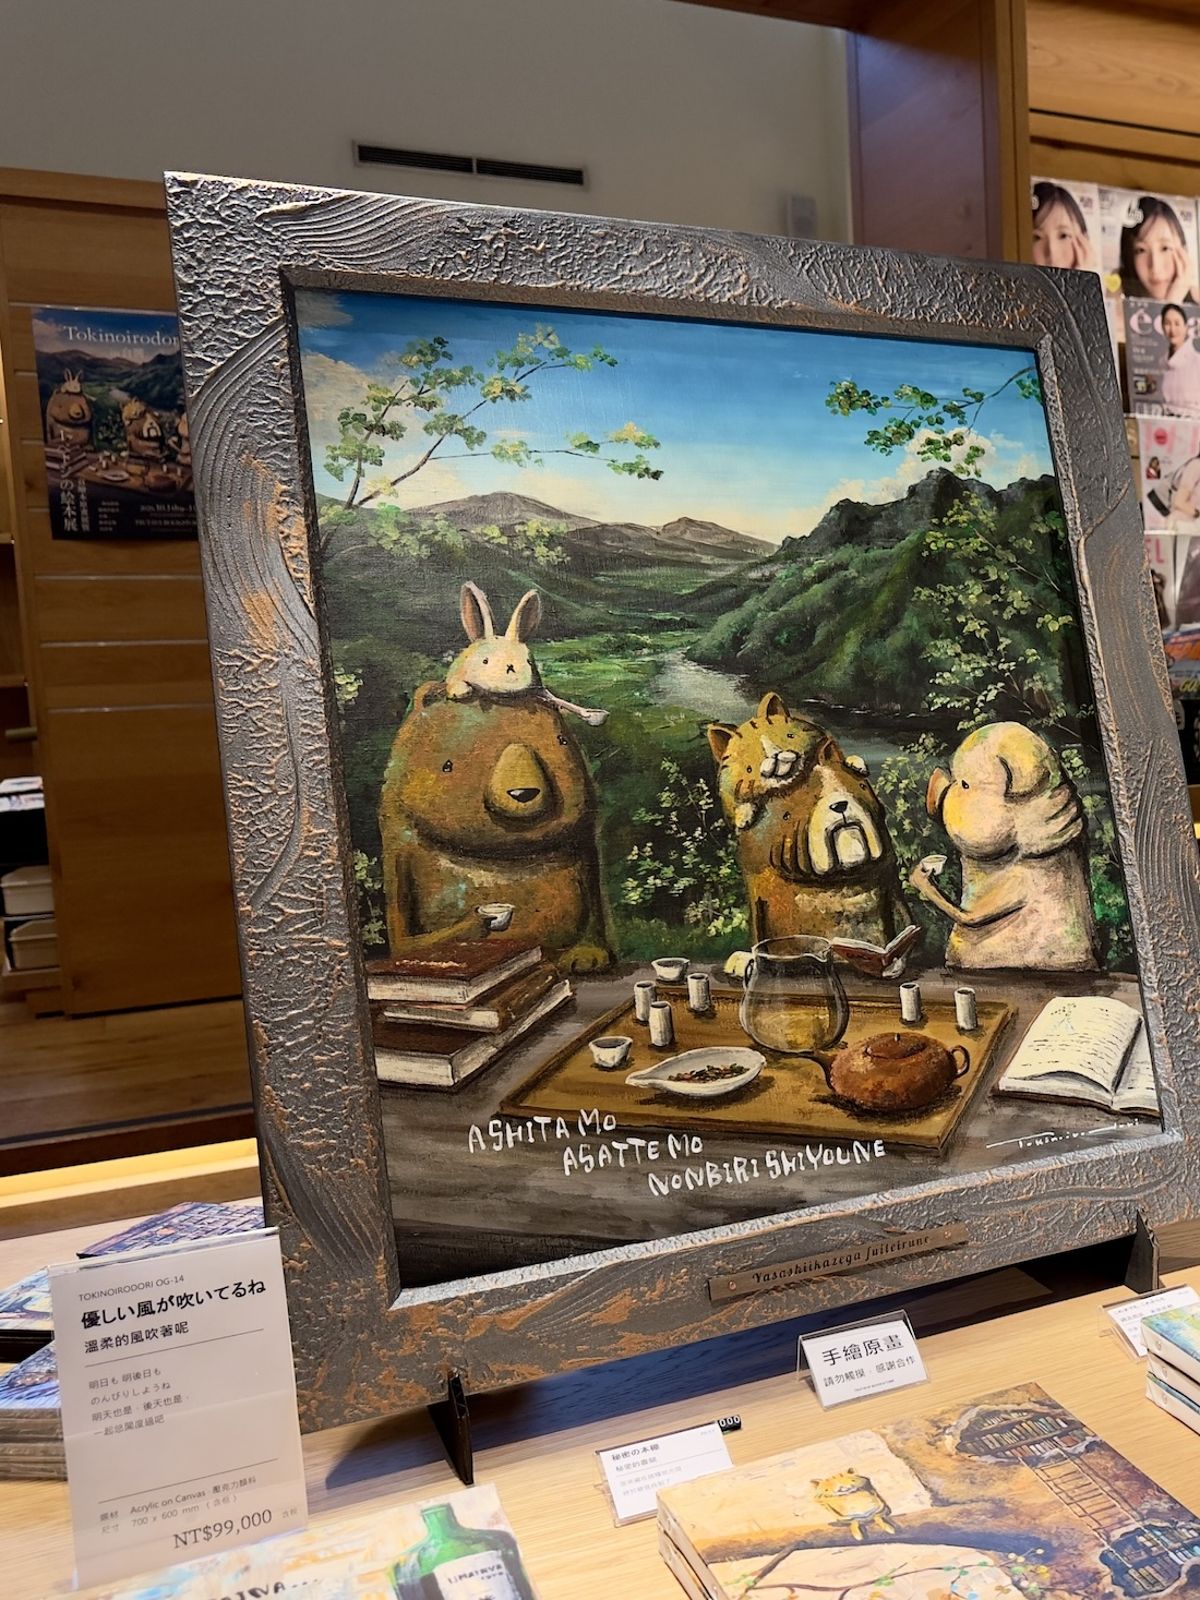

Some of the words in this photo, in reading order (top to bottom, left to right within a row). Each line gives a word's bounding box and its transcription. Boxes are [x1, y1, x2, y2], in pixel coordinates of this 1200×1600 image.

[468, 1115, 570, 1153] ASHITA
[577, 1108, 617, 1137] MO
[563, 1137, 660, 1177] ASATTE
[668, 1133, 703, 1160] MO
[647, 1158, 760, 1197] NONBIRI
[751, 1252, 861, 1285] Yasashiikazega
[78, 1280, 154, 1302] TOKINOIRODORI
[156, 1275, 185, 1288] OG-14
[81, 1279, 267, 1330] 優しい風が吹いてるね
[84, 1321, 190, 1354] 溫柔的風吹著呢
[822, 1334, 904, 1366] 手繪原畫
[90, 1382, 171, 1406] のんびりしようね
[130, 1501, 158, 1515] Acrylic
[161, 1498, 173, 1507] on
[173, 1508, 273, 1549] NT$99,000
